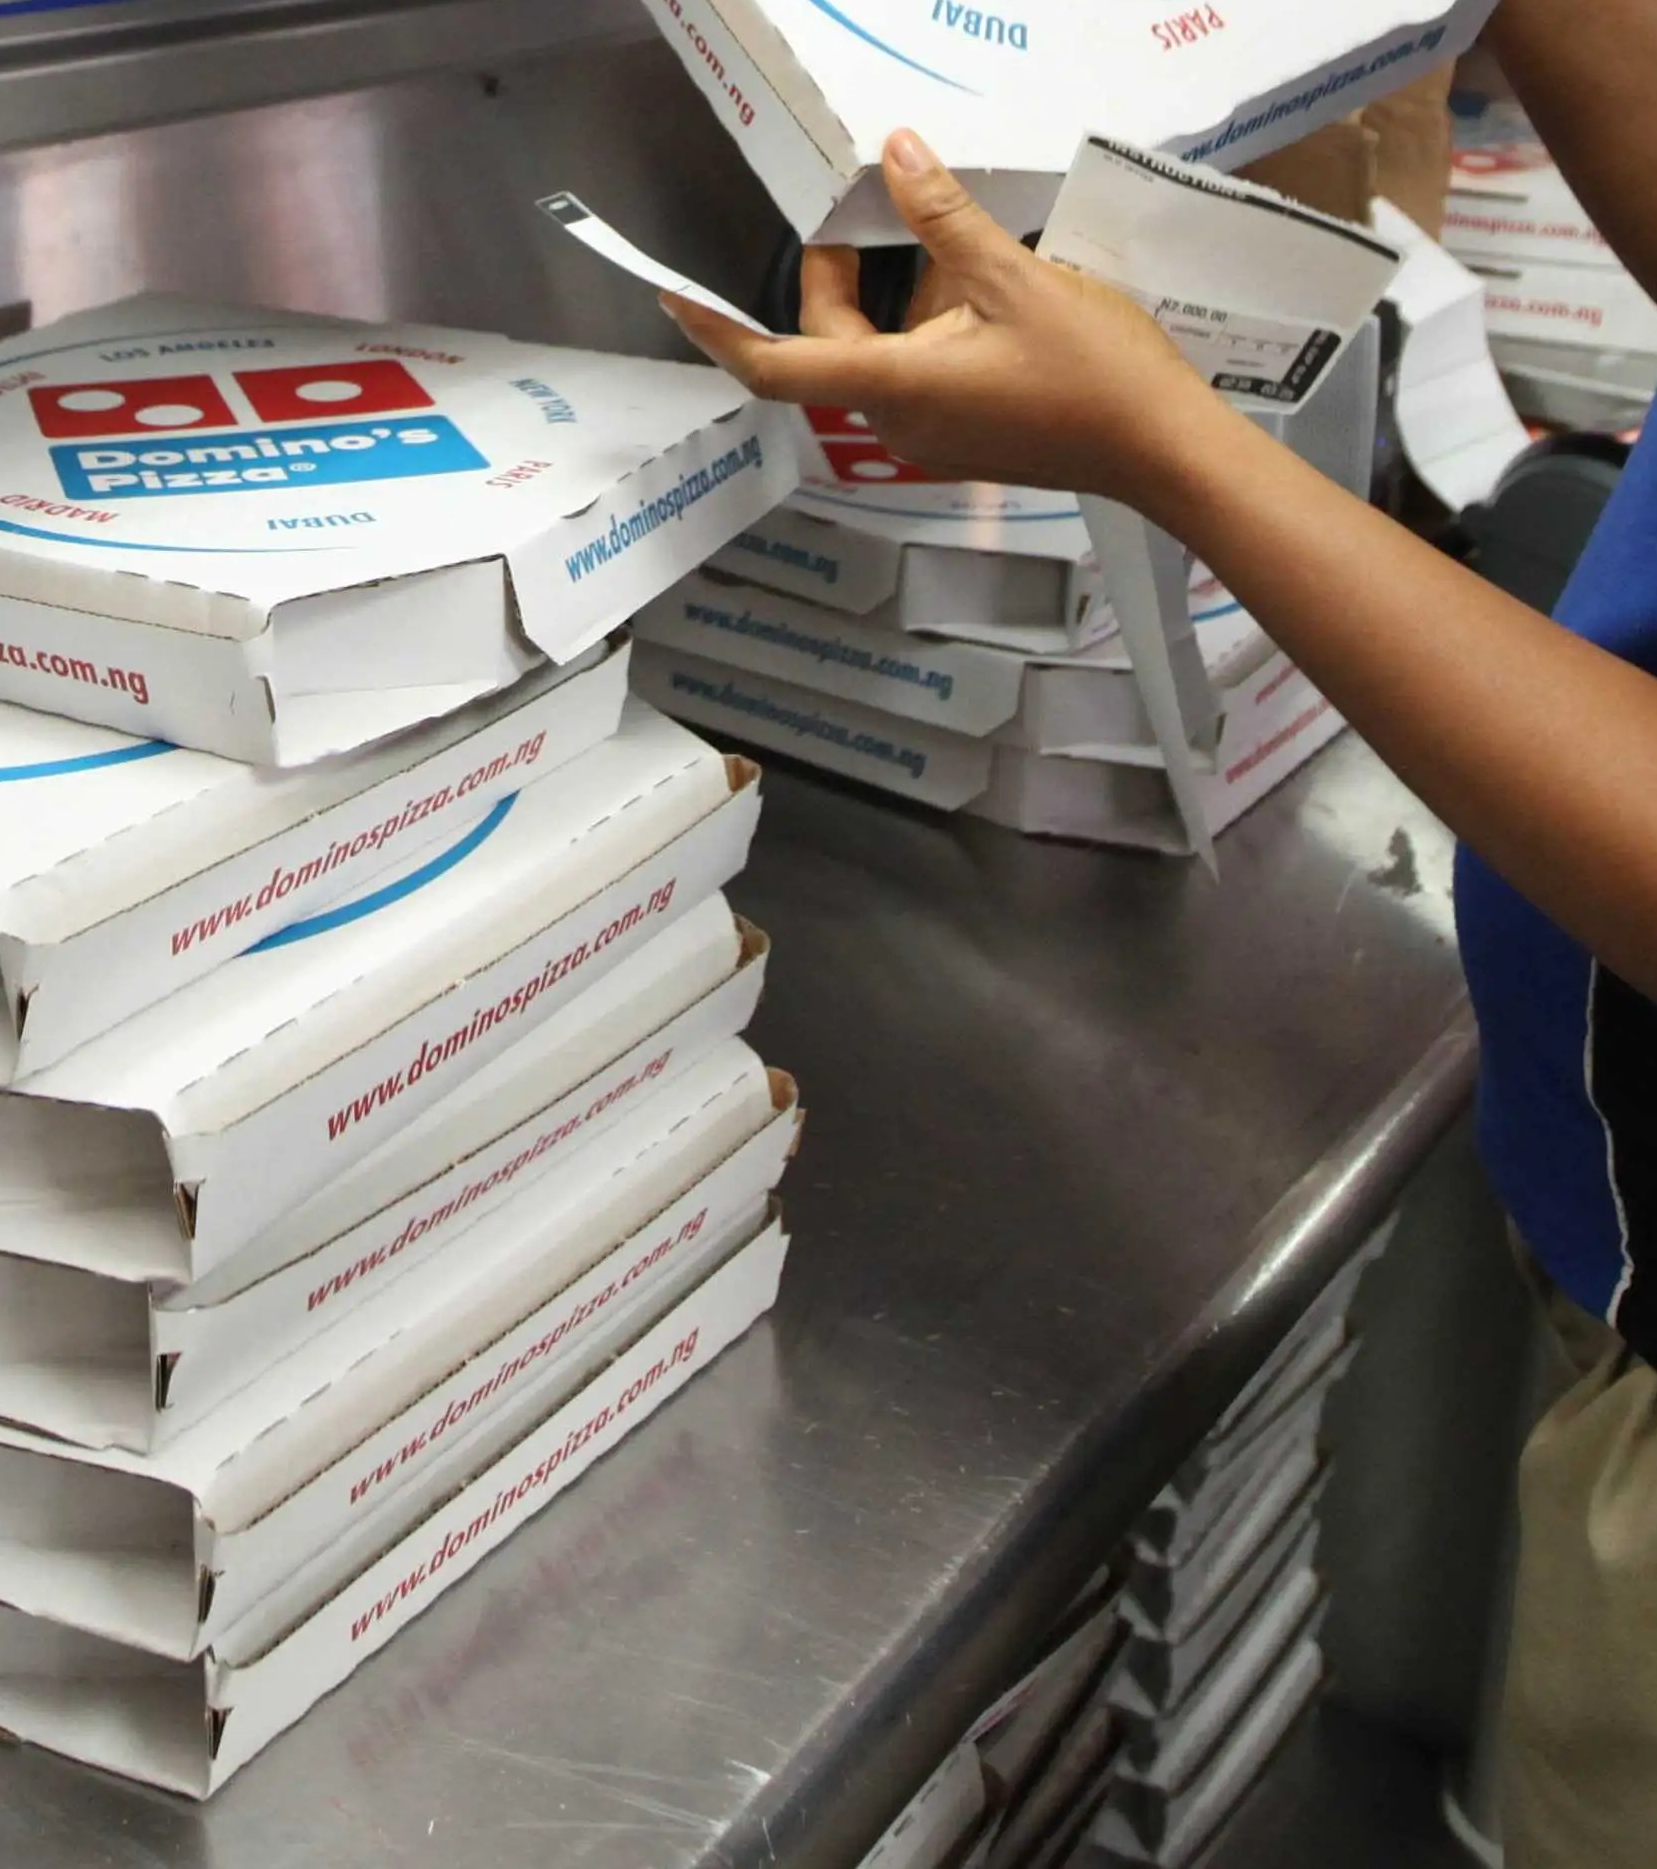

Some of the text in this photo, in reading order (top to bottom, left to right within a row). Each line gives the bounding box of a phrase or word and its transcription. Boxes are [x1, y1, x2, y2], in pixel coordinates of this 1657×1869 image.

[1150, 2, 1226, 52] PARIS
[100, 347, 150, 364] LOS
[354, 338, 467, 366] LONDON
[75, 428, 441, 472] Domino's
[484, 458, 554, 491] PARIS
[264, 510, 379, 531] DUBAI
[564, 432, 764, 585] www.dominospizza.com.ng
[168, 727, 547, 959] www.dominospizza.com.ng
[324, 872, 679, 1145] www.dominospizza.com.ng
[304, 1042, 675, 1315] www.dominospizza.com.ng
[346, 1204, 710, 1508] www.dominospizza.com.ng
[348, 1323, 702, 1646] www.dominospizza.com.ng
